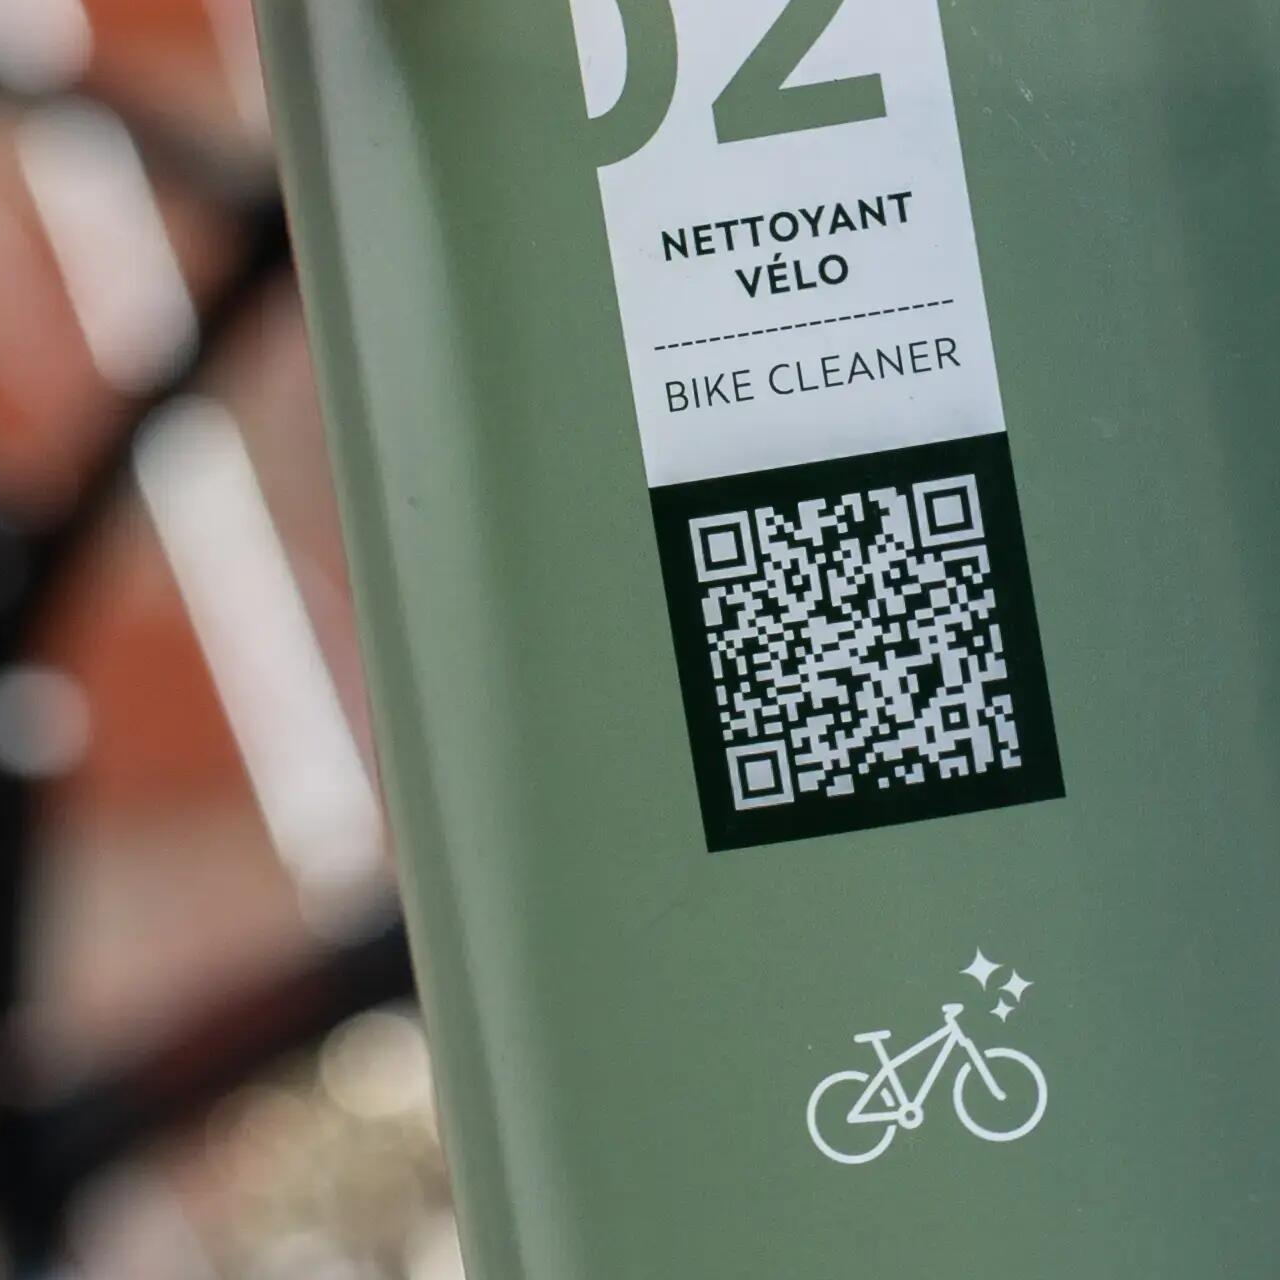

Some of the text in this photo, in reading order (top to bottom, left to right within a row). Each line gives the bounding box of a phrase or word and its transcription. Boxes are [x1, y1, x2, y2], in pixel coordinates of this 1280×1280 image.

[661, 191, 913, 262] NETTOYANT
[734, 251, 849, 298] VÉLO
[665, 337, 961, 413] BIKE CLEANER
